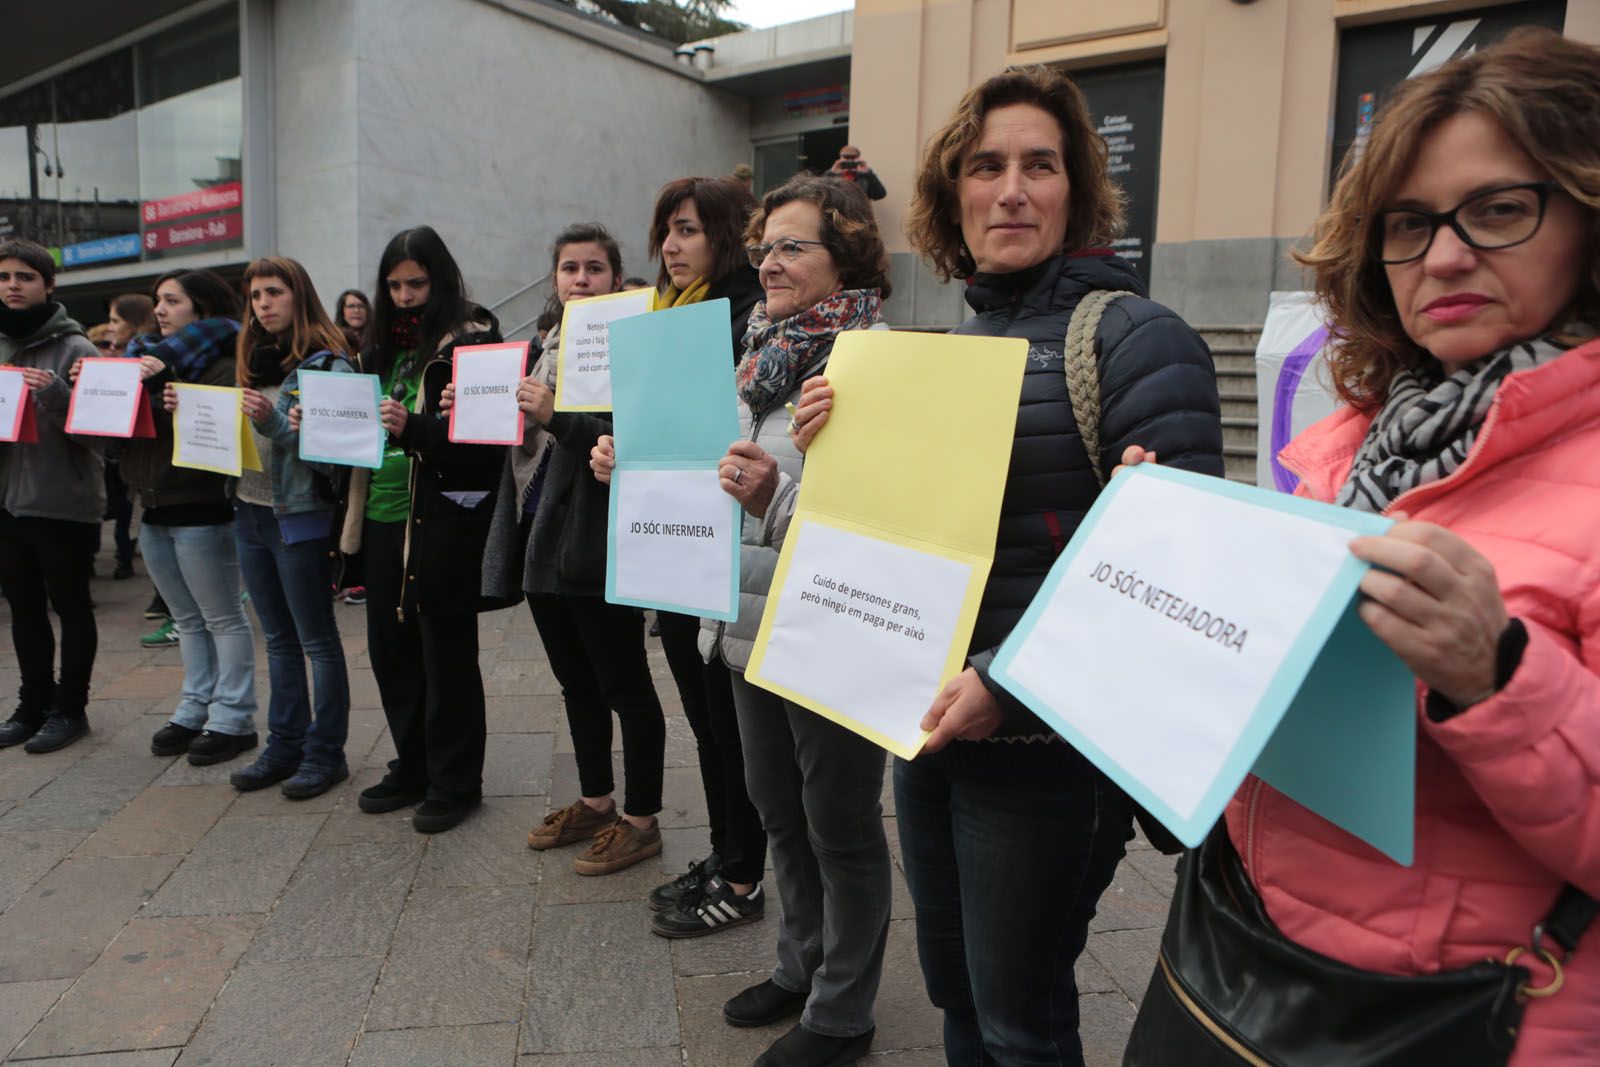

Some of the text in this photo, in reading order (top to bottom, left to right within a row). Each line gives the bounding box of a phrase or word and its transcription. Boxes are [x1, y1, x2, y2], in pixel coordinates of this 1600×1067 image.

[169, 226, 204, 245] Barcelona
[586, 322, 605, 332] Netejo
[576, 338, 591, 346] cuino
[595, 336, 605, 345] faig
[577, 350, 590, 360] però
[578, 364, 590, 373] això
[464, 384, 510, 396] JO SÓC BOMBERA
[310, 407, 369, 420] JO SÓC CAMBRERA
[630, 520, 714, 538] JO SÓC INFERMERA
[813, 574, 921, 621] Cuido de persones grans,
[1090, 561, 1248, 653] JO SÓC NETEJADORA
[800, 590, 925, 641] però ningú em paga per això
